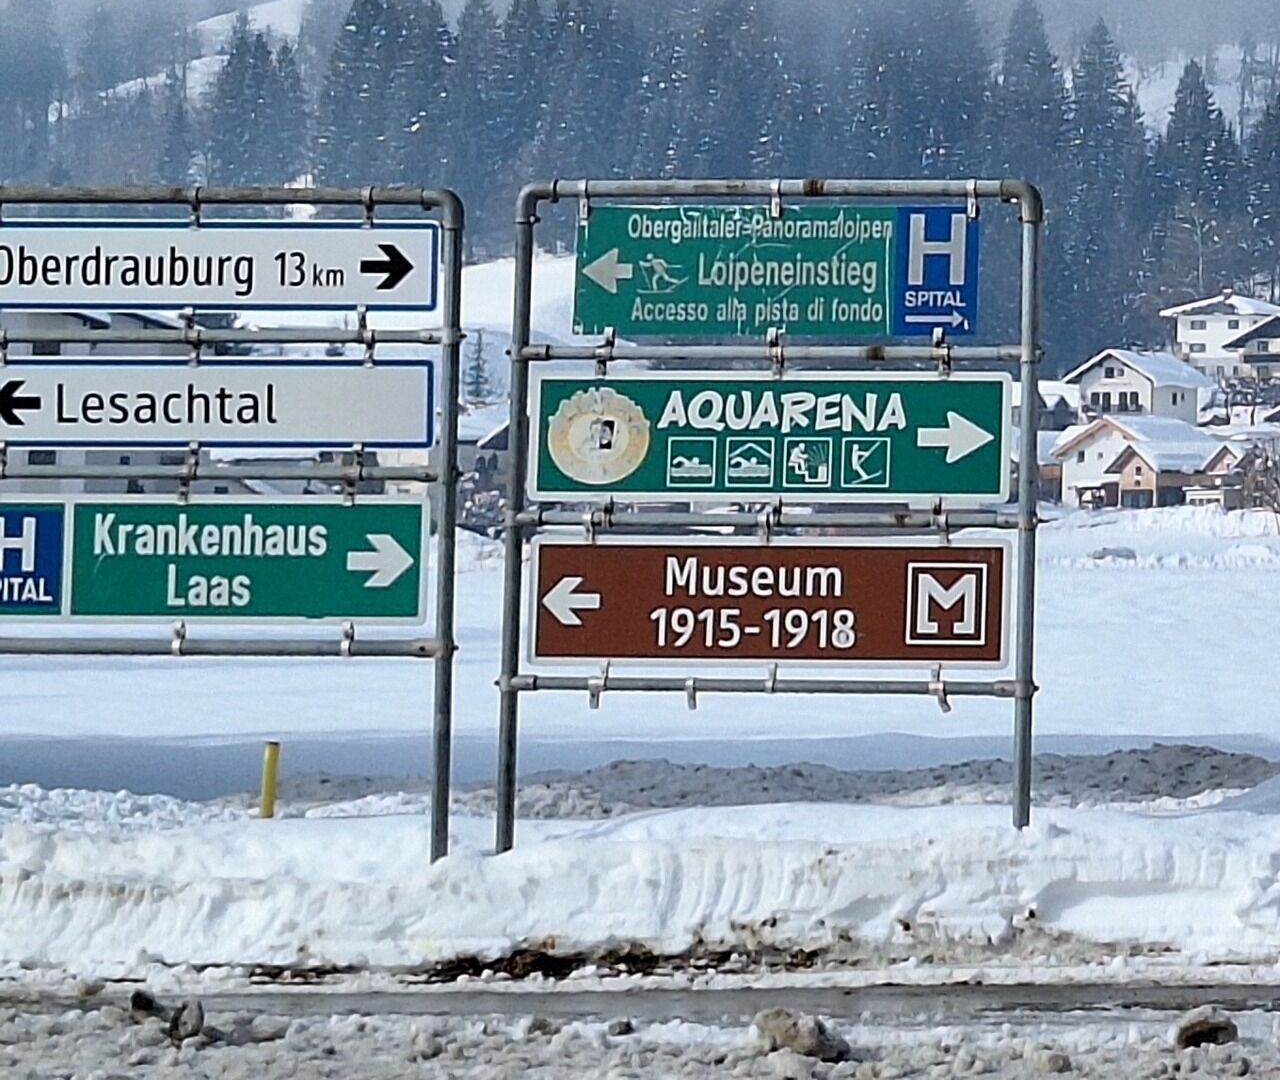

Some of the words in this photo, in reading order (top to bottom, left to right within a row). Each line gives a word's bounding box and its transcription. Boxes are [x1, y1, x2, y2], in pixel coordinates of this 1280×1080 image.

[274, 252, 306, 287] 13
[313, 264, 344, 287] km
[907, 213, 966, 286] H
[698, 253, 878, 293] Loipeneinstieg
[631, 297, 708, 322] Accesso
[716, 297, 750, 322] alla
[755, 297, 799, 328] pista
[806, 296, 825, 321] di
[831, 296, 884, 322] fondo
[904, 291, 966, 308] SPITAL
[56, 383, 278, 424] Lesachtal
[657, 390, 907, 433] AQUARENA
[93, 513, 328, 556] Krankenhaus
[0, 577, 53, 602] ITAL
[167, 564, 250, 607] Laas
[665, 556, 843, 598] Museum
[650, 607, 857, 649] 1915-1918
